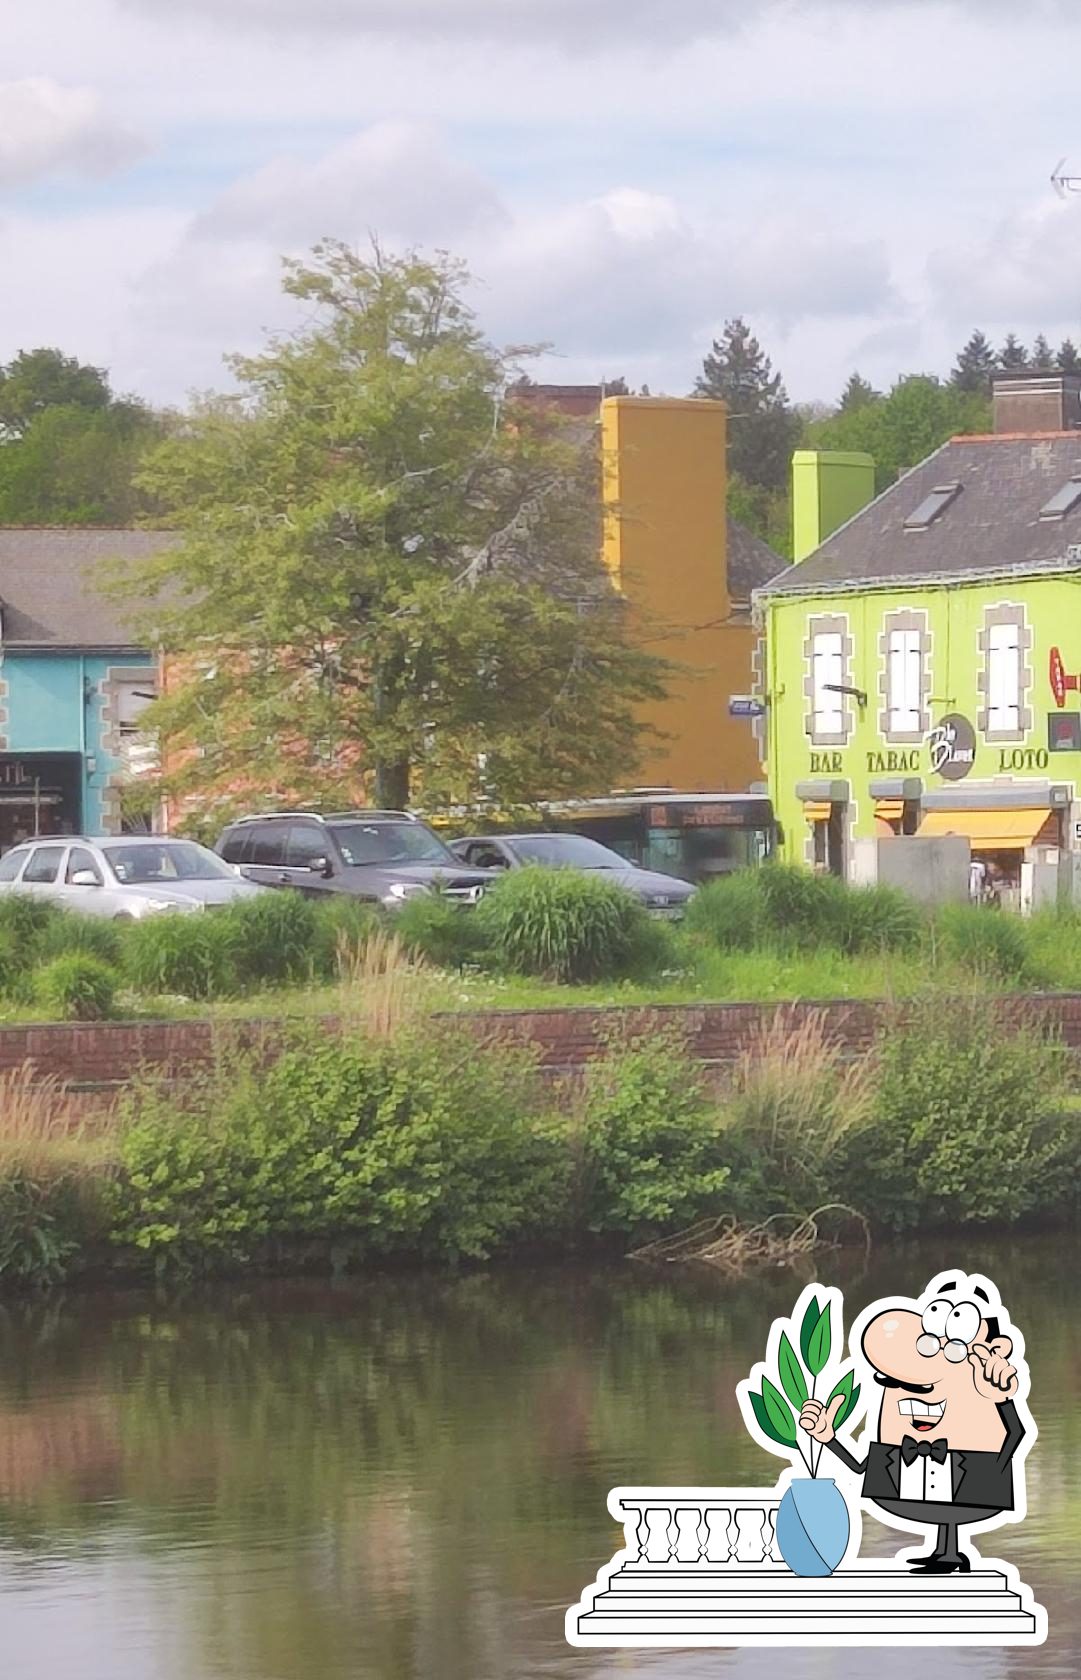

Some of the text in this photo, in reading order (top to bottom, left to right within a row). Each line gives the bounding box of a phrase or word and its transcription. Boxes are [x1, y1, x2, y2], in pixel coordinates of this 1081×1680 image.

[810, 752, 842, 772] BAR
[866, 750, 920, 772] TABAC
[1000, 748, 1049, 770] LOTO
